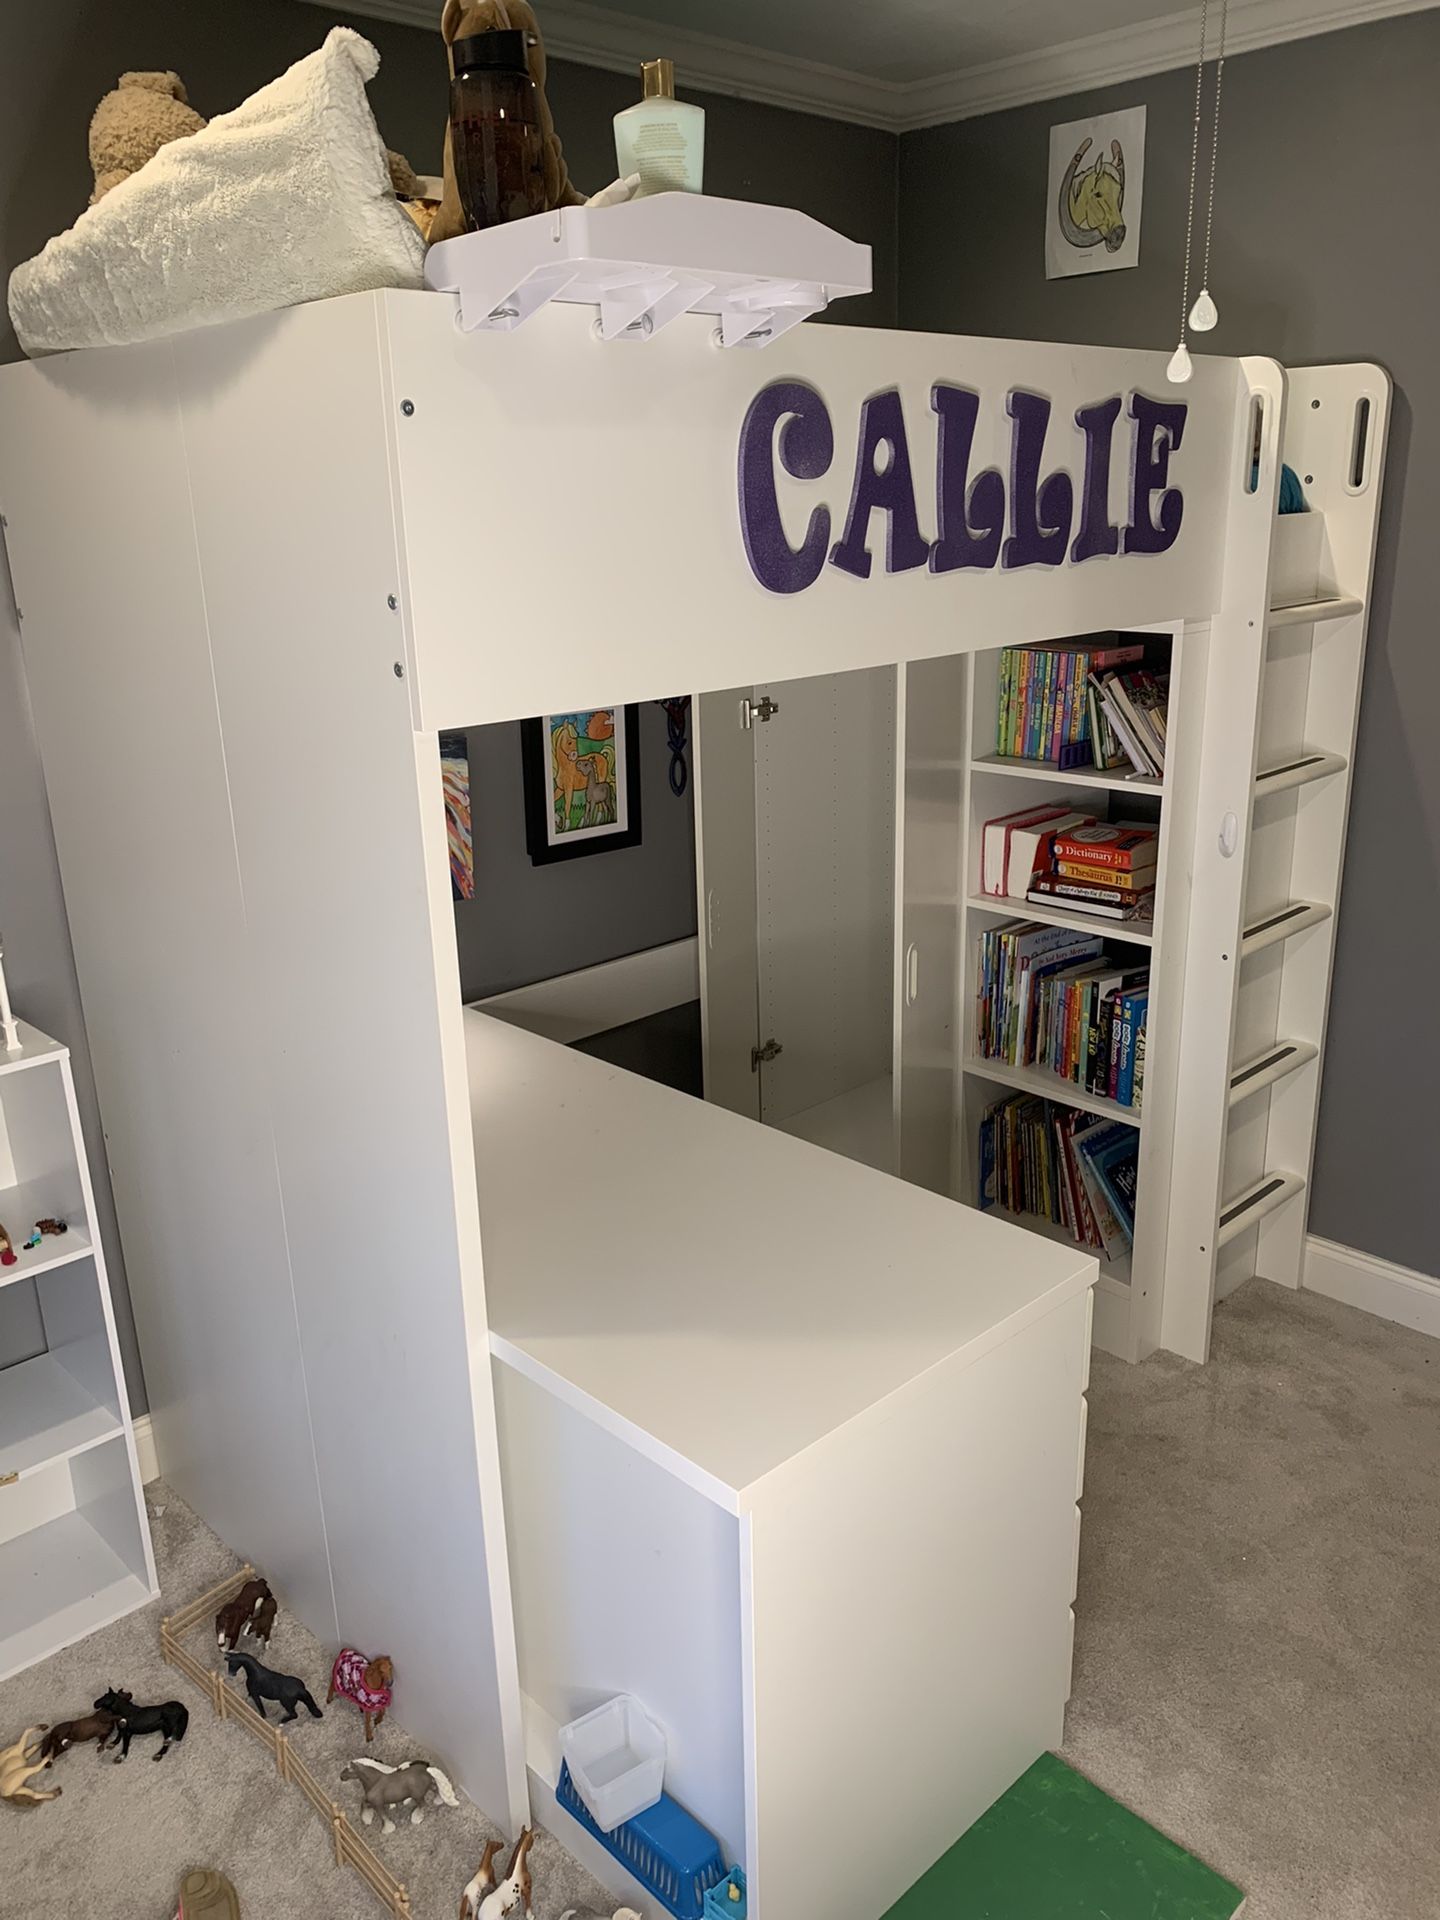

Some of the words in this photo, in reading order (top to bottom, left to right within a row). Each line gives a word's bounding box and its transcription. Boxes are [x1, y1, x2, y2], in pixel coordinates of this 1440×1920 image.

[738, 379, 1188, 595] CALLIE
[1065, 845, 1113, 863] Dictionary
[1069, 866, 1113, 883] Thesaurus
